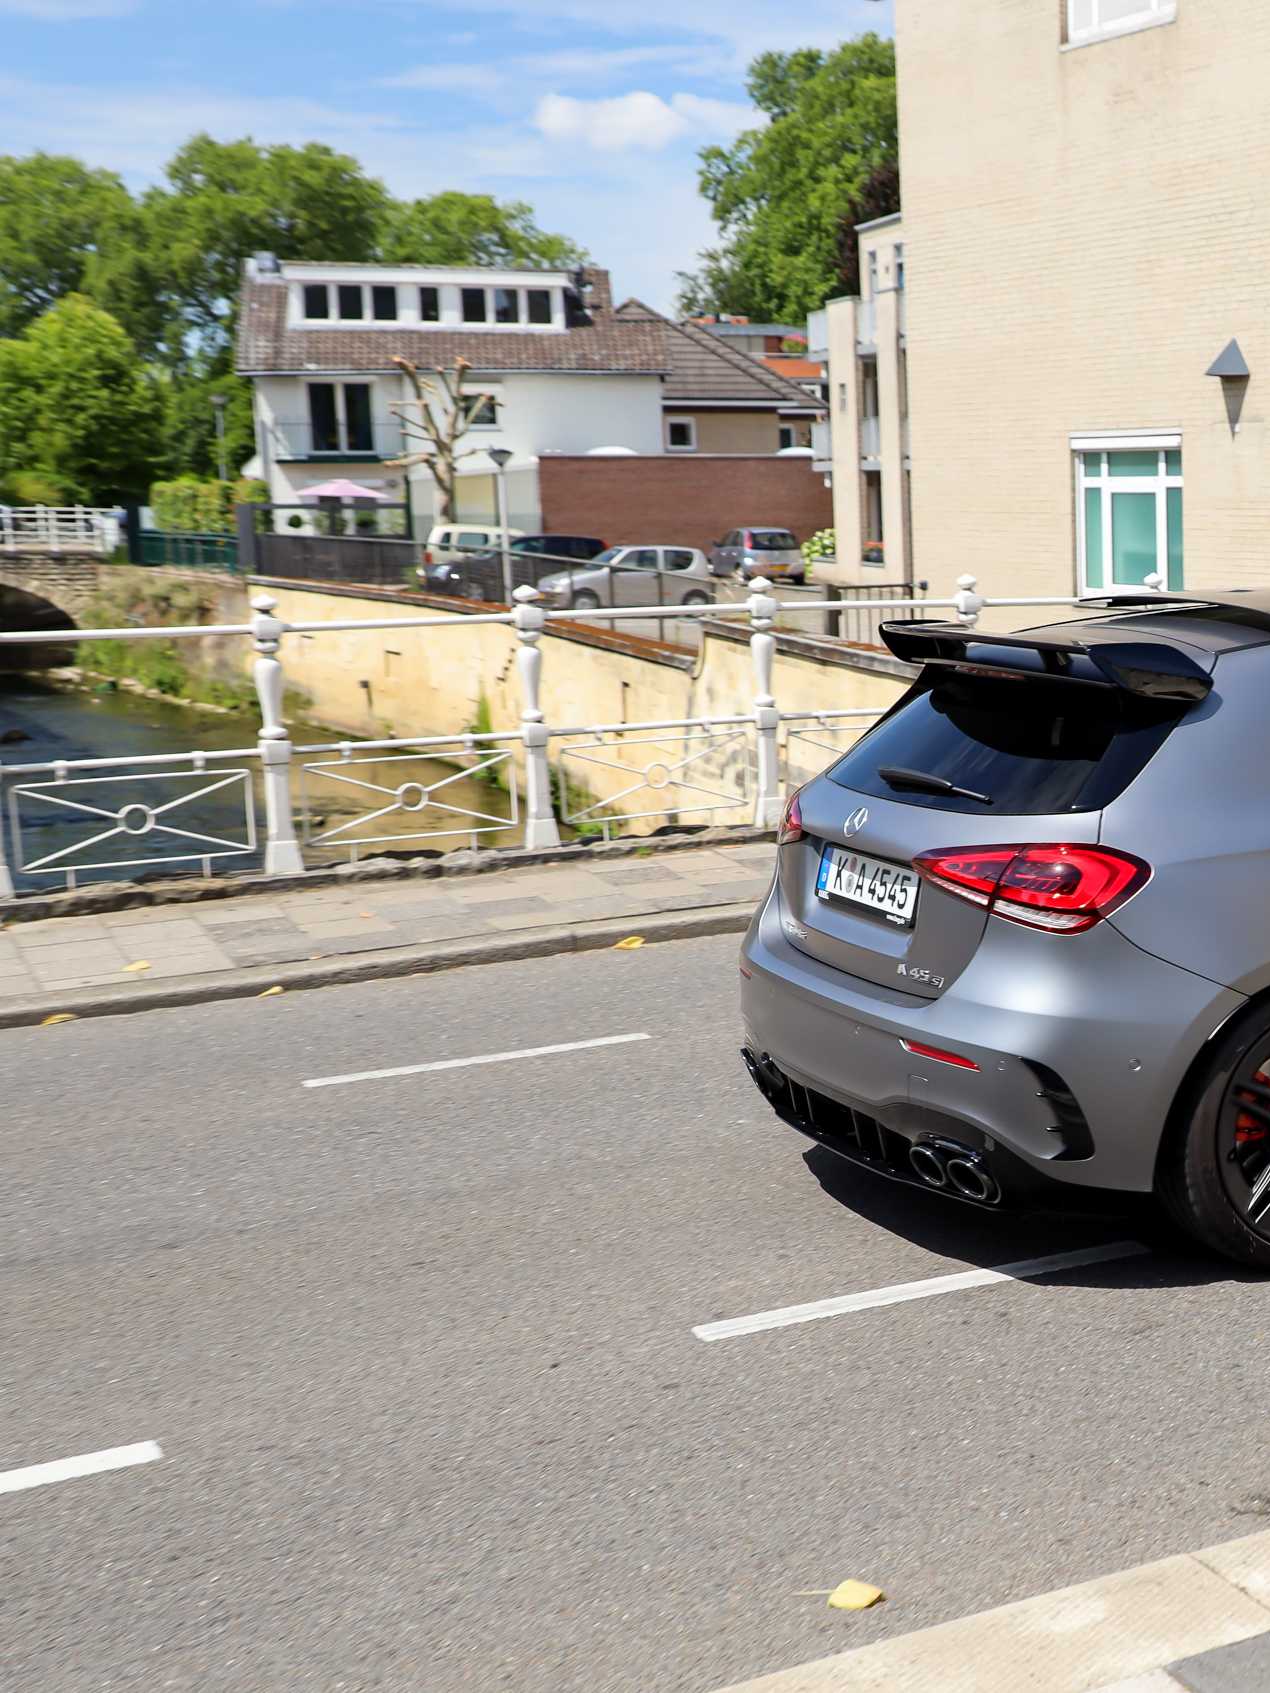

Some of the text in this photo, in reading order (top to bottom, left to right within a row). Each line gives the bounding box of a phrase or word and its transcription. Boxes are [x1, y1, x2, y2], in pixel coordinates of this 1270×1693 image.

[821, 872, 828, 882] D
[833, 856, 849, 891] K
[896, 963, 907, 976] A
